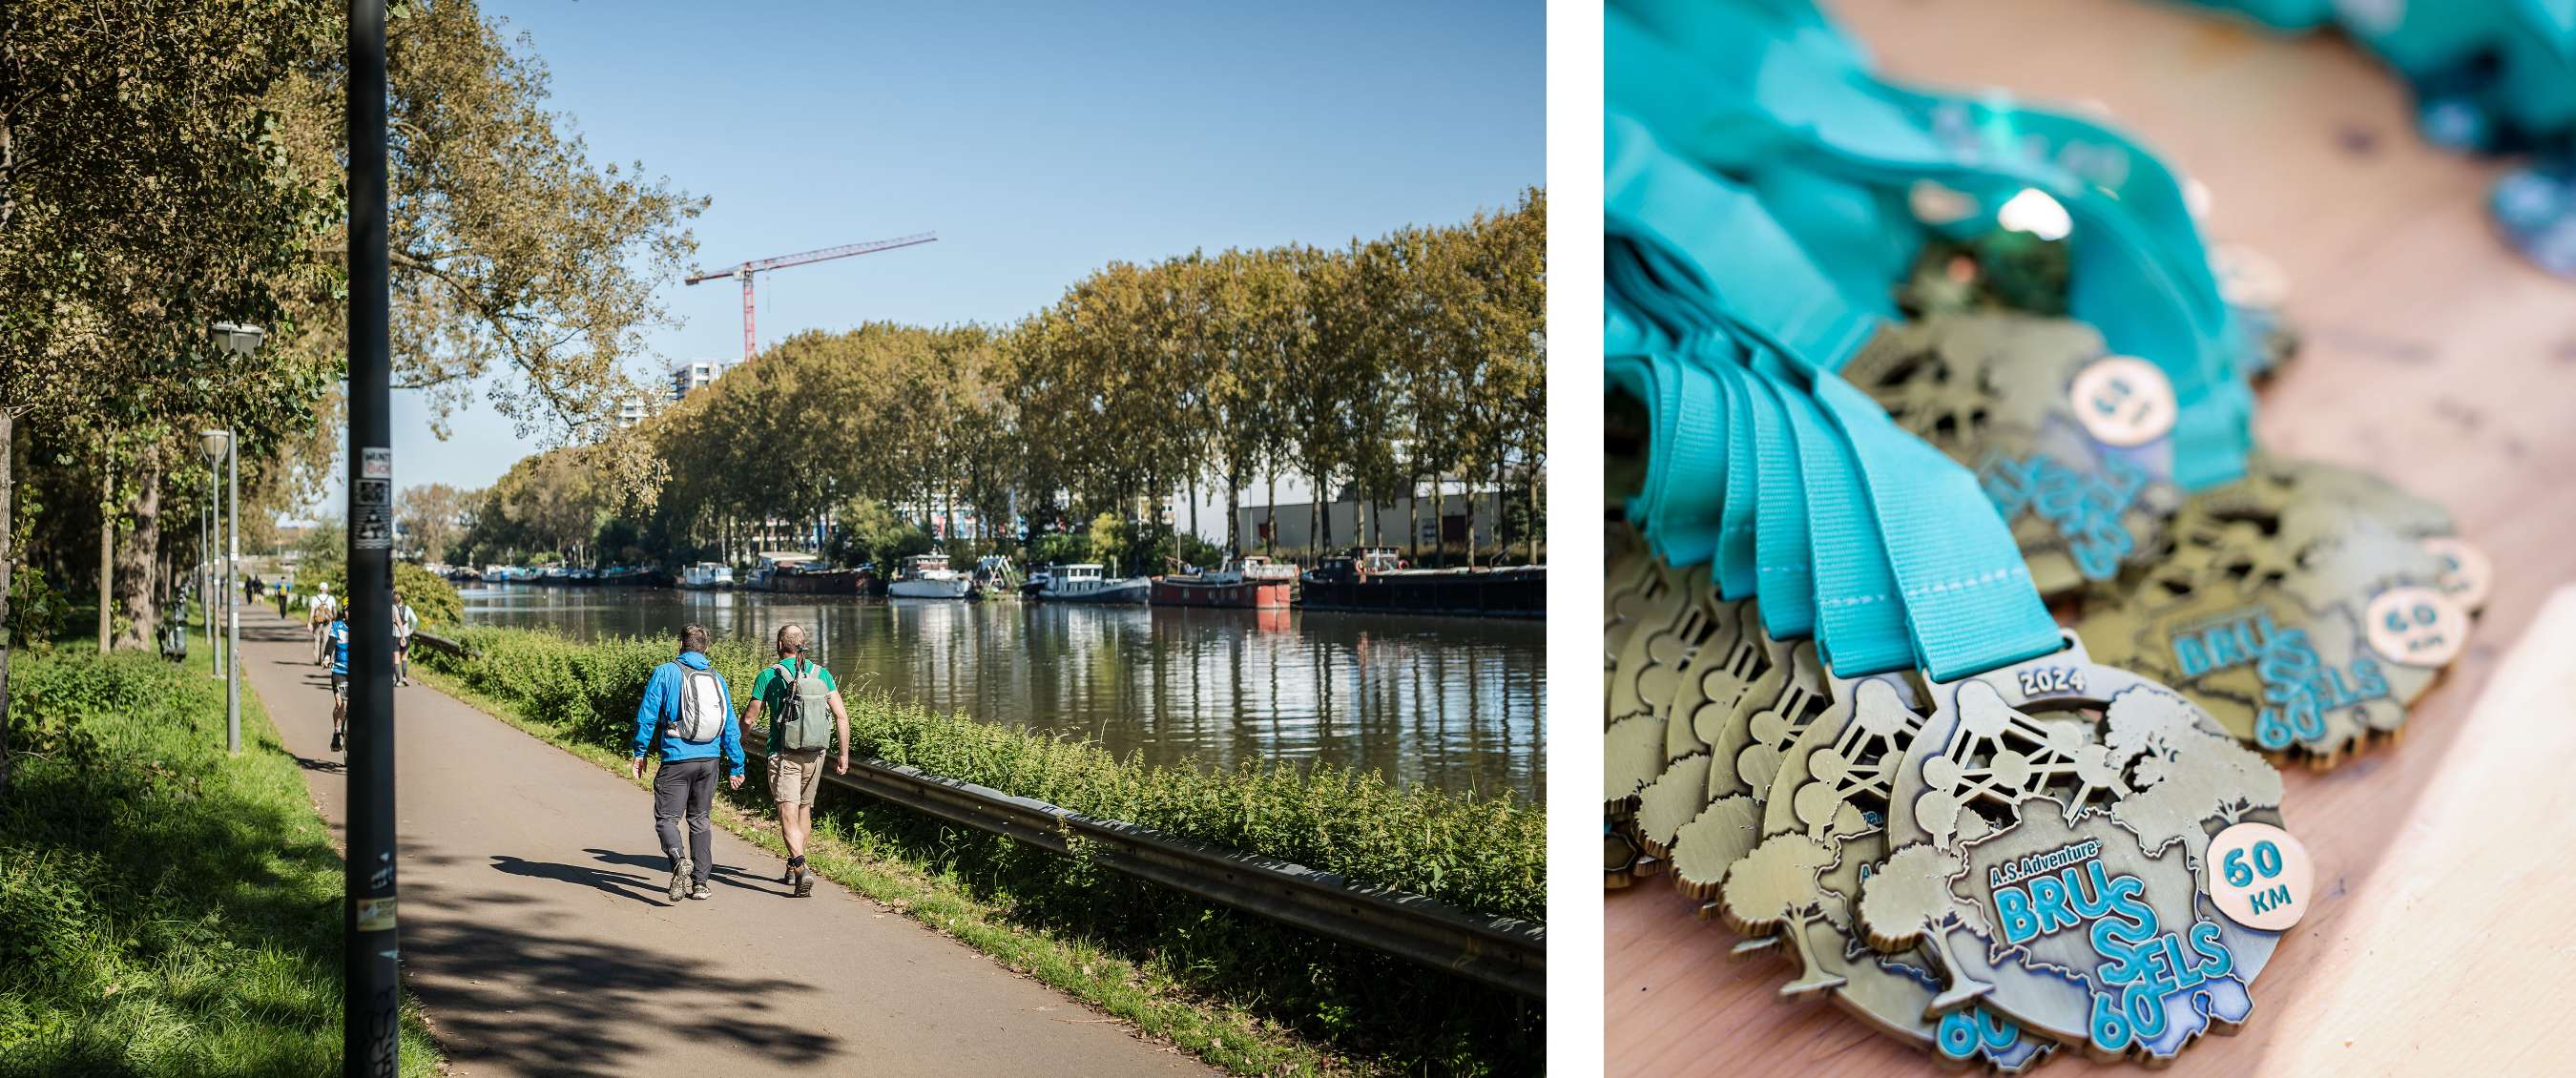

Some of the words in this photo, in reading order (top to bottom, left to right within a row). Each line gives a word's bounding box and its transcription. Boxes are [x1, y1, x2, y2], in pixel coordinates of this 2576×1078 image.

[2018, 669, 2085, 695] 2024
[2223, 840, 2283, 887] 60
[2250, 884, 2292, 916] KM
[2088, 979, 2169, 1051] 60
